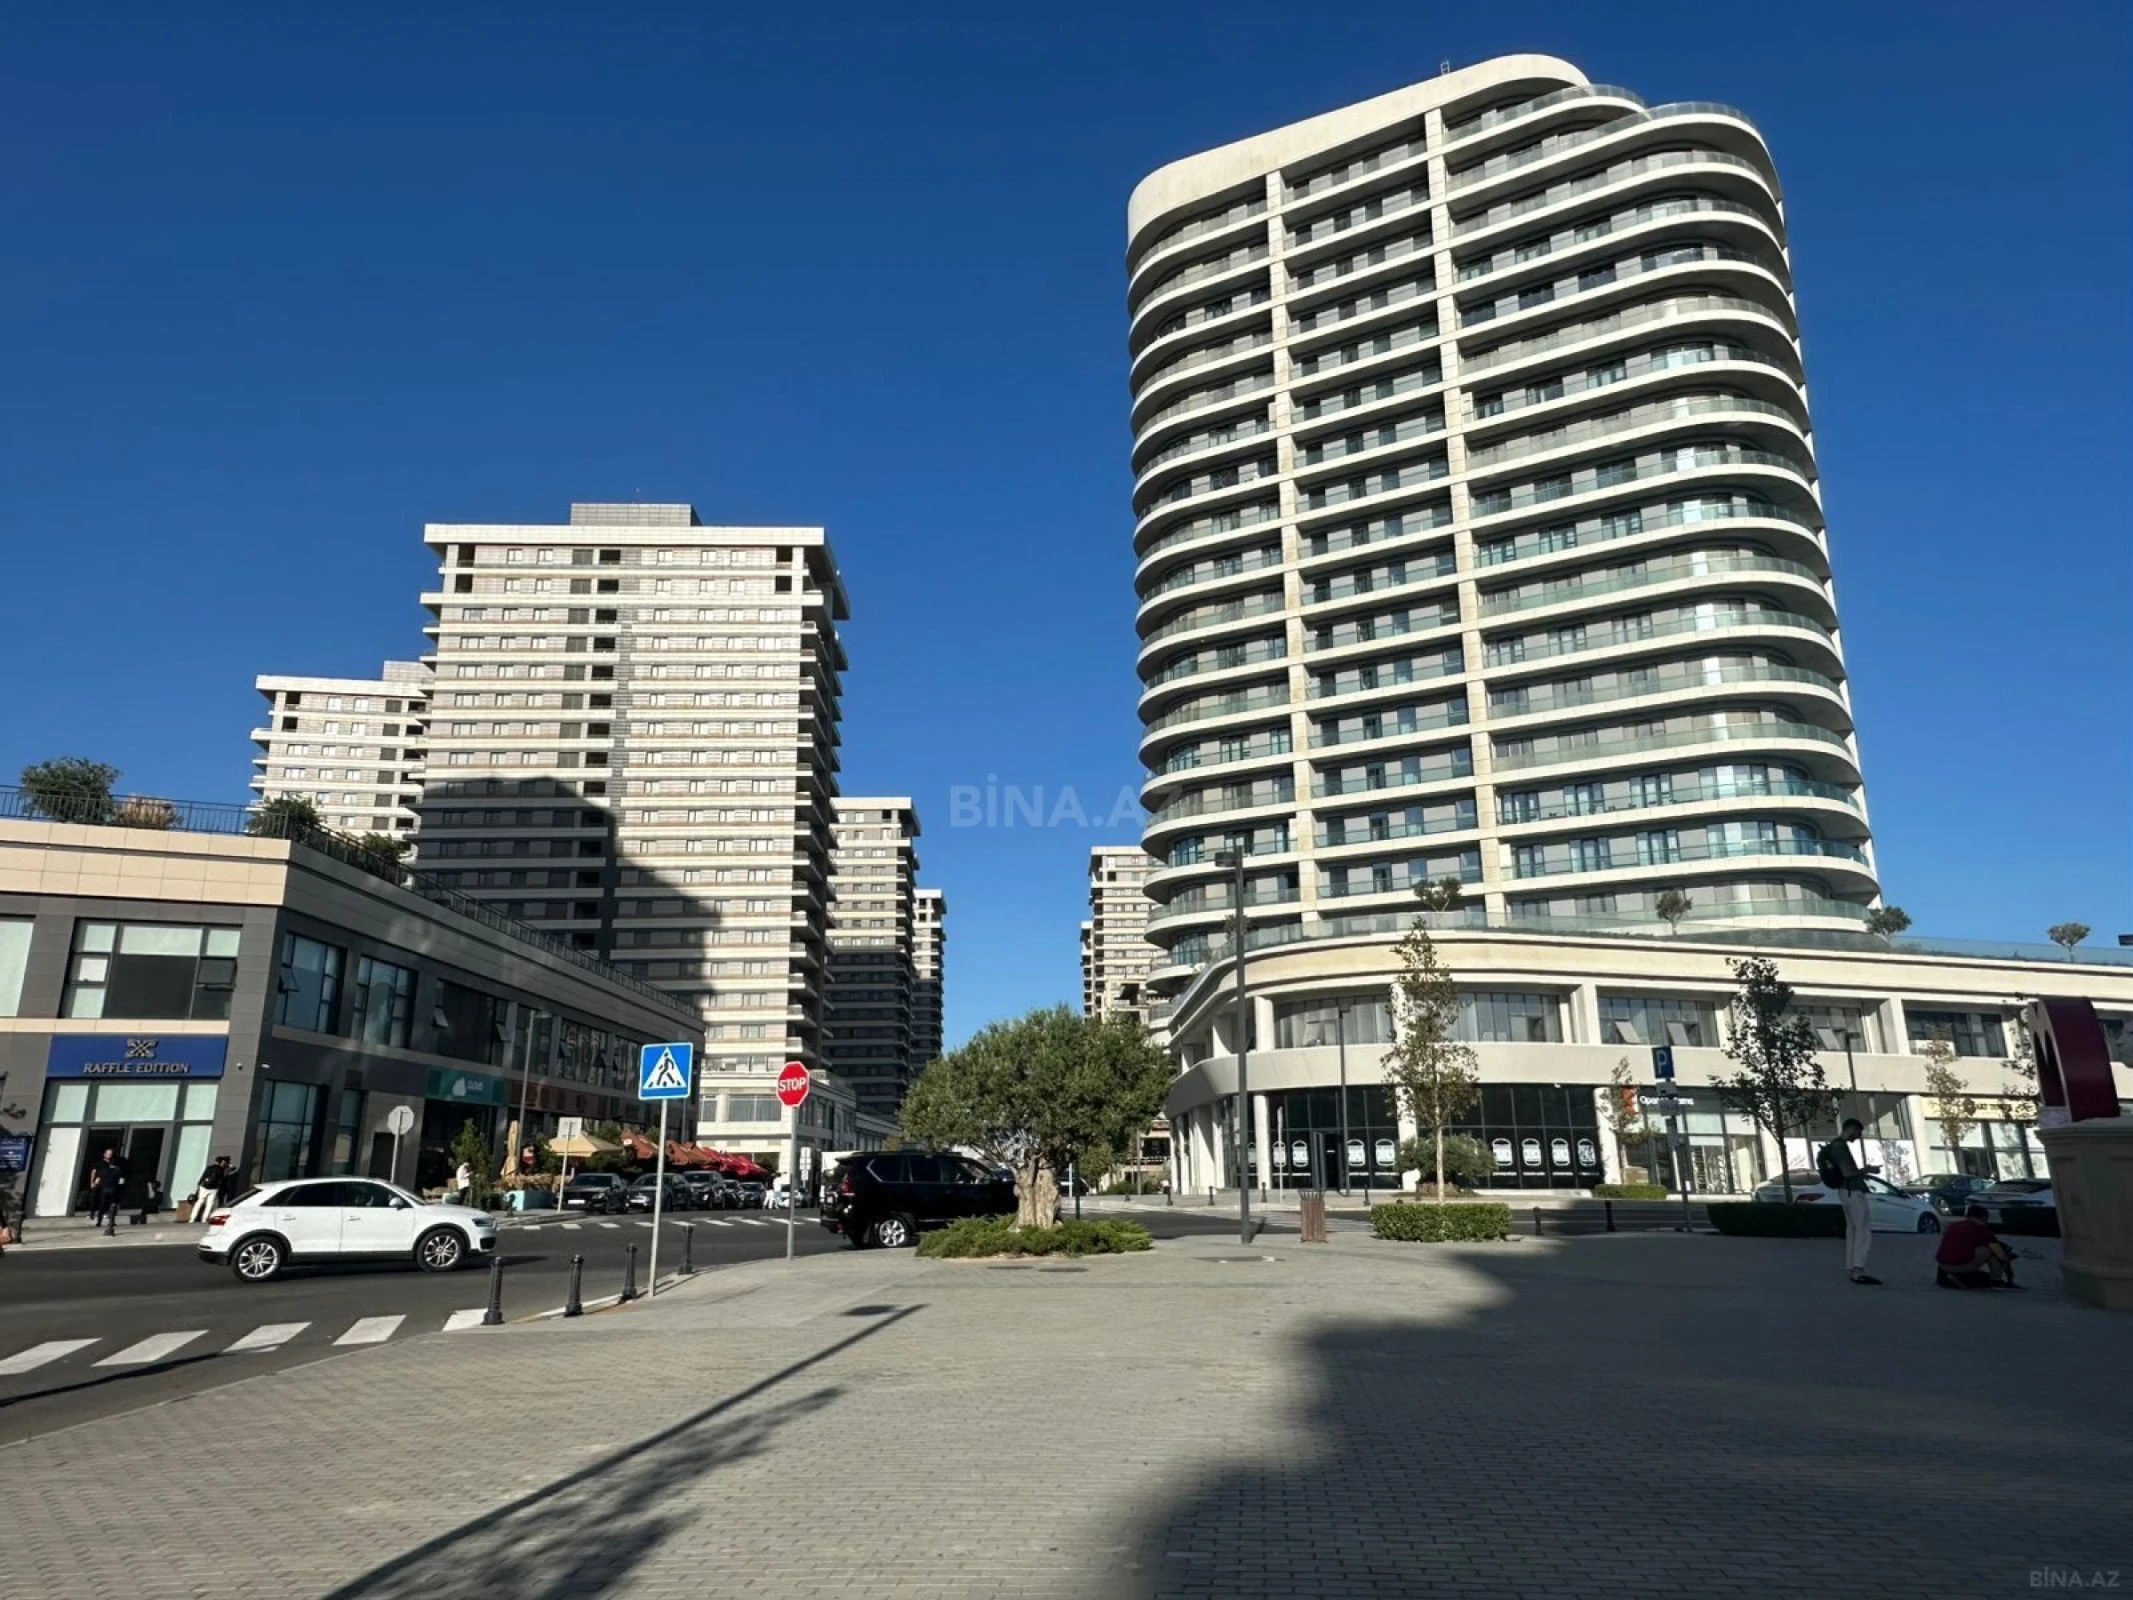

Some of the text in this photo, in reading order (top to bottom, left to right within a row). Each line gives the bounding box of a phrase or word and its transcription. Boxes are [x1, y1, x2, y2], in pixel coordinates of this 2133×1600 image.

[83, 1062, 190, 1073] RAFFLE EDITION
[1656, 1050, 1668, 1075] P
[780, 1077, 806, 1092] STOP
